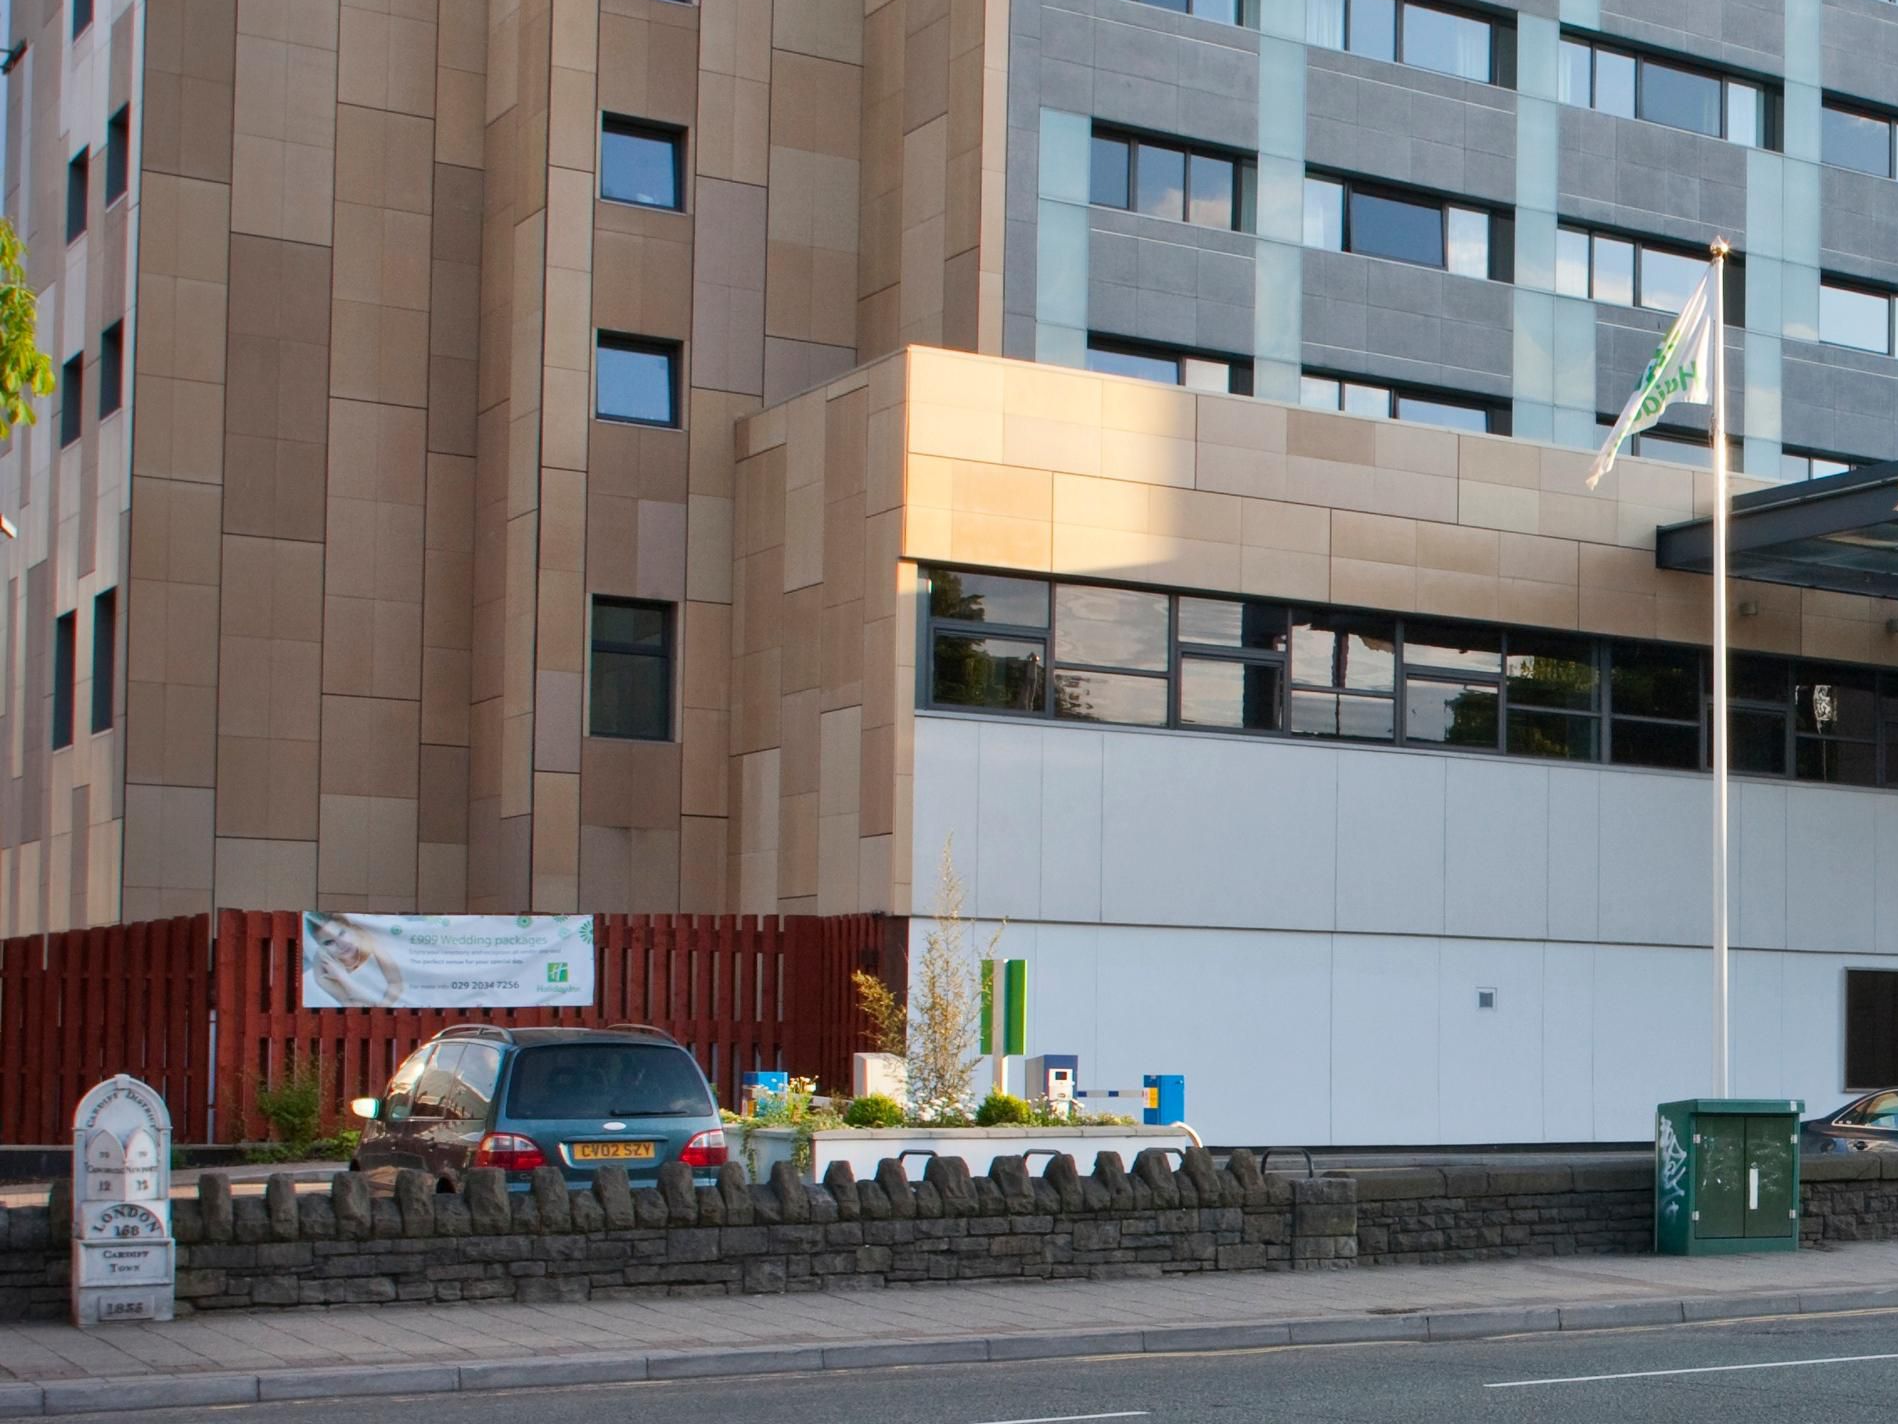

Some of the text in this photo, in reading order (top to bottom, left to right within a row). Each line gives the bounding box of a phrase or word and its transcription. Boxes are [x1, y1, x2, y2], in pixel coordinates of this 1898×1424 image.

[410, 935, 547, 947] £999 Wedding packages
[451, 981, 469, 990] 029
[472, 981, 494, 990] 2034
[496, 981, 520, 990] 7256
[582, 1143, 651, 1157] CV02 SZY
[92, 1206, 160, 1233] LONDON
